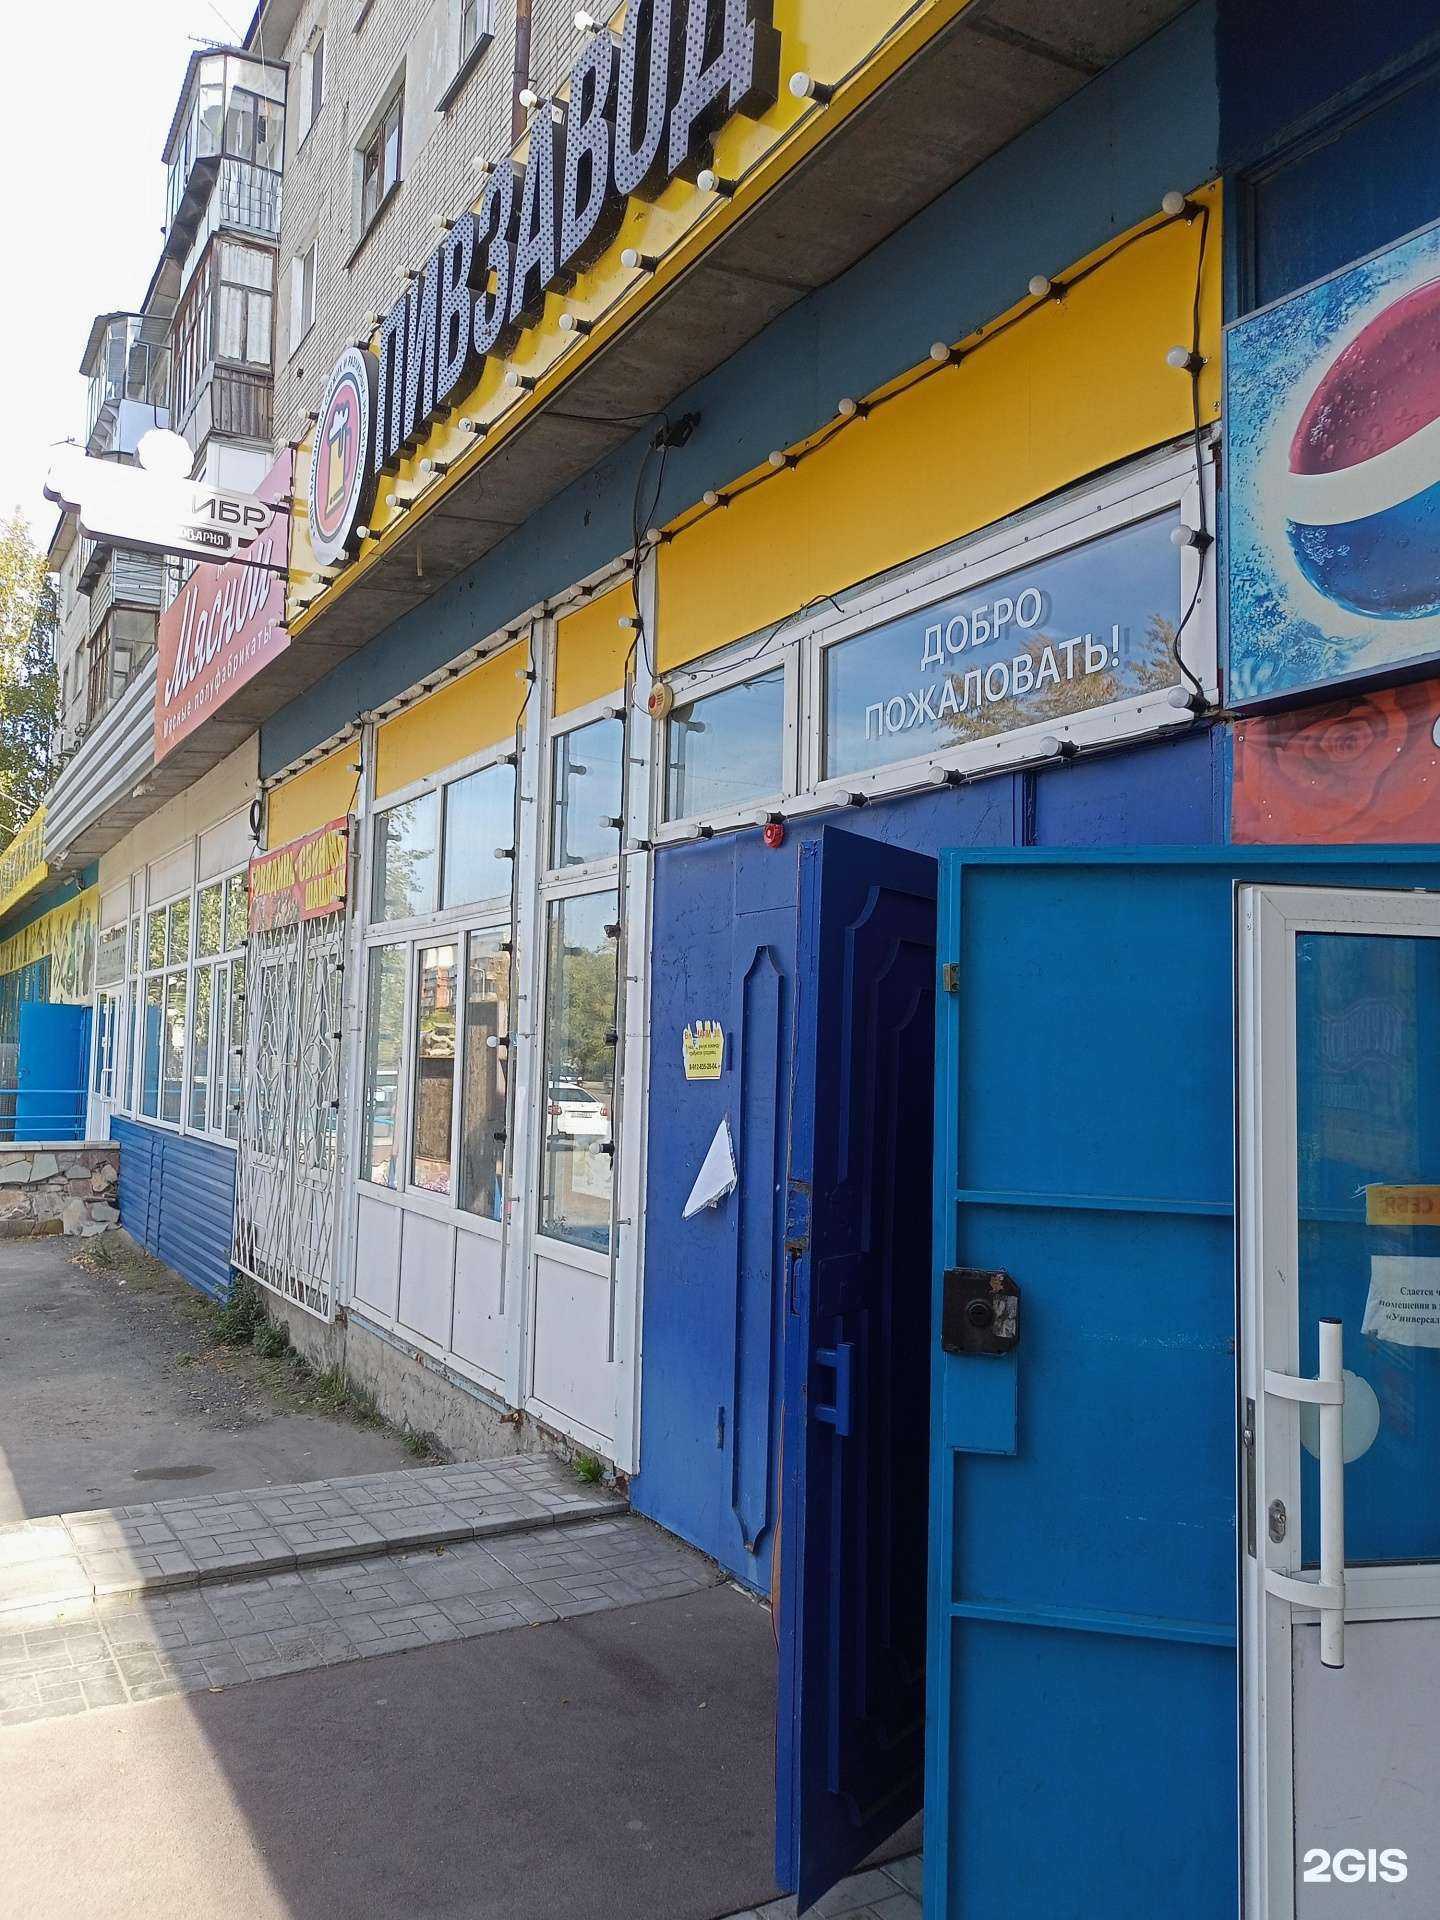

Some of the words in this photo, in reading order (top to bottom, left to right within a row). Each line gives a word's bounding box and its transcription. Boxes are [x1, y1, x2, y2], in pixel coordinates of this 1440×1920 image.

[920, 586, 1043, 672] ДОБРО
[864, 623, 1120, 740] ПОЖАЛОВАТЬ!
[1400, 1286, 1434, 1296] Сдается
